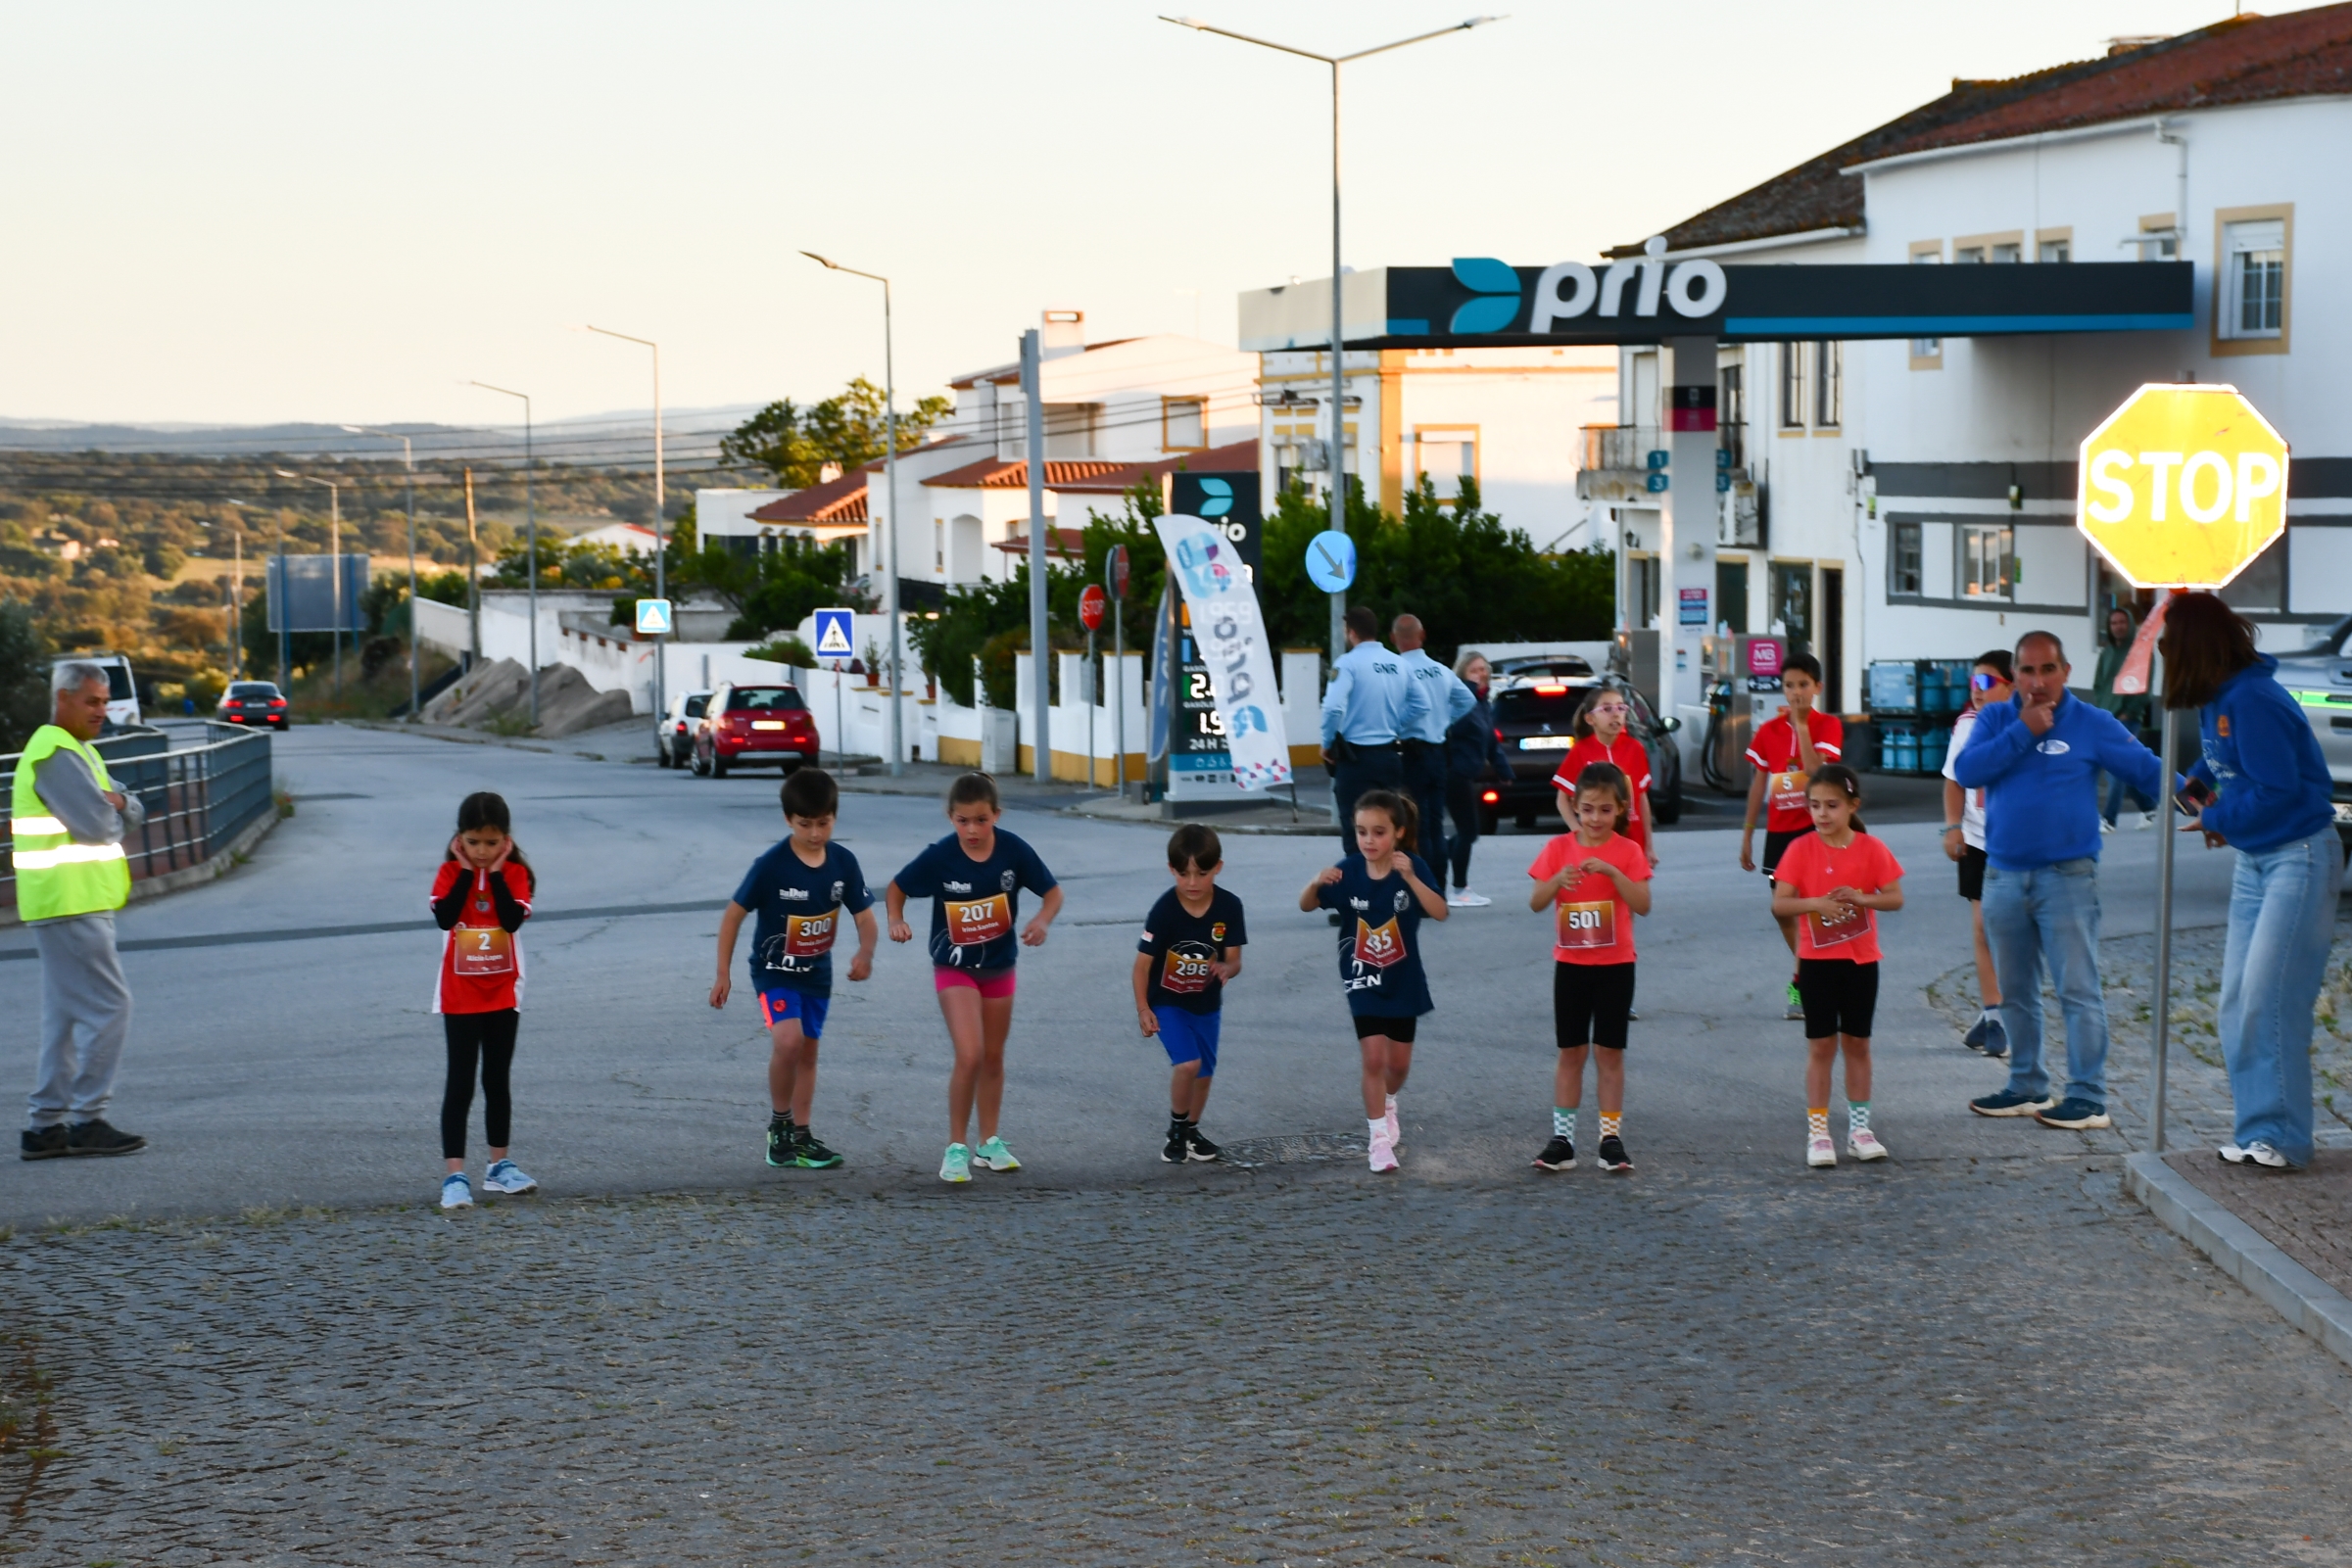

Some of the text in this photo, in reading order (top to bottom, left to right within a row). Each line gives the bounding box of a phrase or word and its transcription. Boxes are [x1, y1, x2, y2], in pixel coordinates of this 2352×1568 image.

[1529, 235, 1727, 334] prio
[2087, 449, 2281, 523] STOP
[1372, 662, 1399, 675] GNR
[1414, 666, 1443, 680] GNR
[1782, 776, 1794, 790] 5
[959, 901, 995, 923] 207
[1568, 910, 1602, 929] 501
[799, 917, 832, 937] 300
[978, 922, 999, 931] Santos
[478, 933, 491, 950] 2
[1176, 960, 1209, 976] 298
